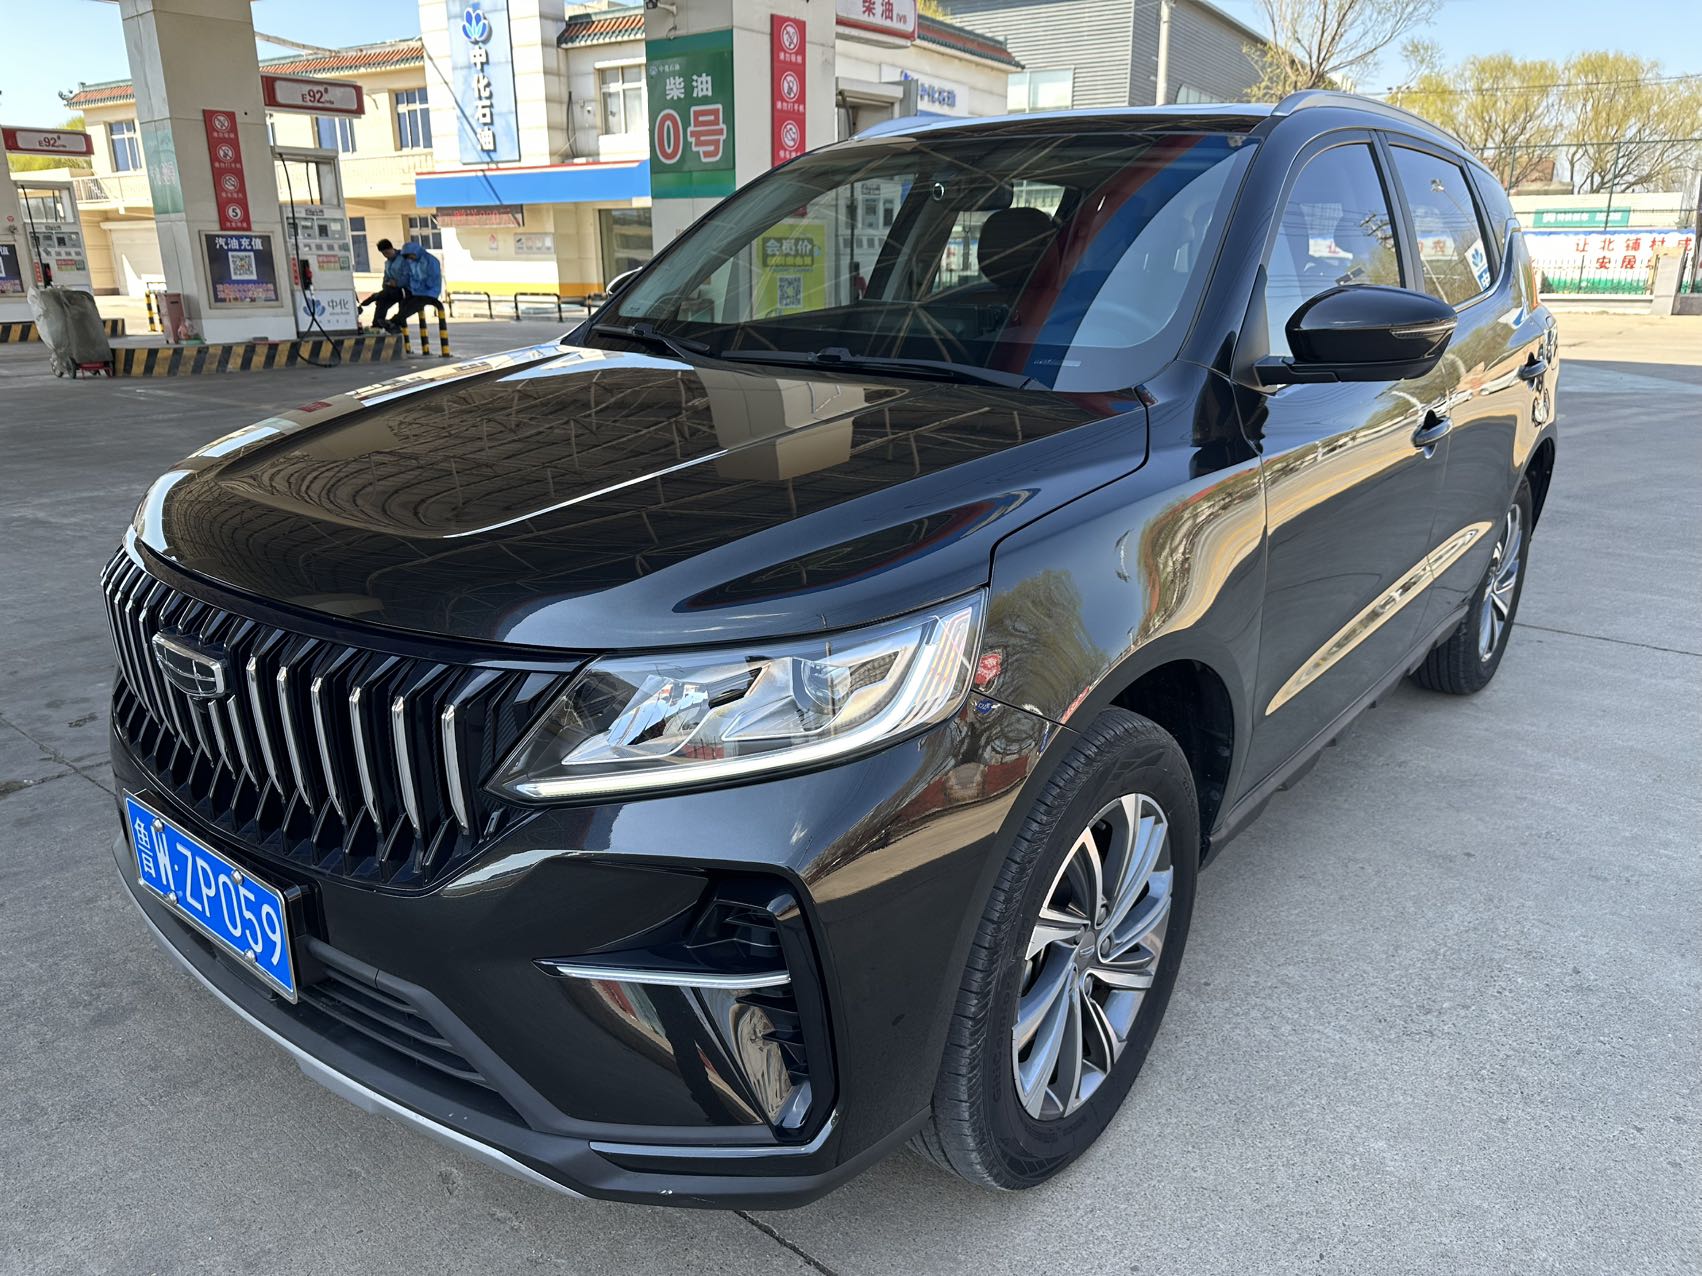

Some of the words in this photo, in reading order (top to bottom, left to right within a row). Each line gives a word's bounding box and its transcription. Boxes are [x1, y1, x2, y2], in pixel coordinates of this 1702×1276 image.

[862, 0, 894, 22] 柴油
[665, 72, 713, 101] 柴油
[470, 45, 495, 151] 中化石油
[655, 104, 726, 165] 0号
[231, 207, 239, 218] 5
[215, 236, 264, 251] 汽油充值
[765, 239, 813, 256] 会员价
[327, 298, 350, 311] 中化
